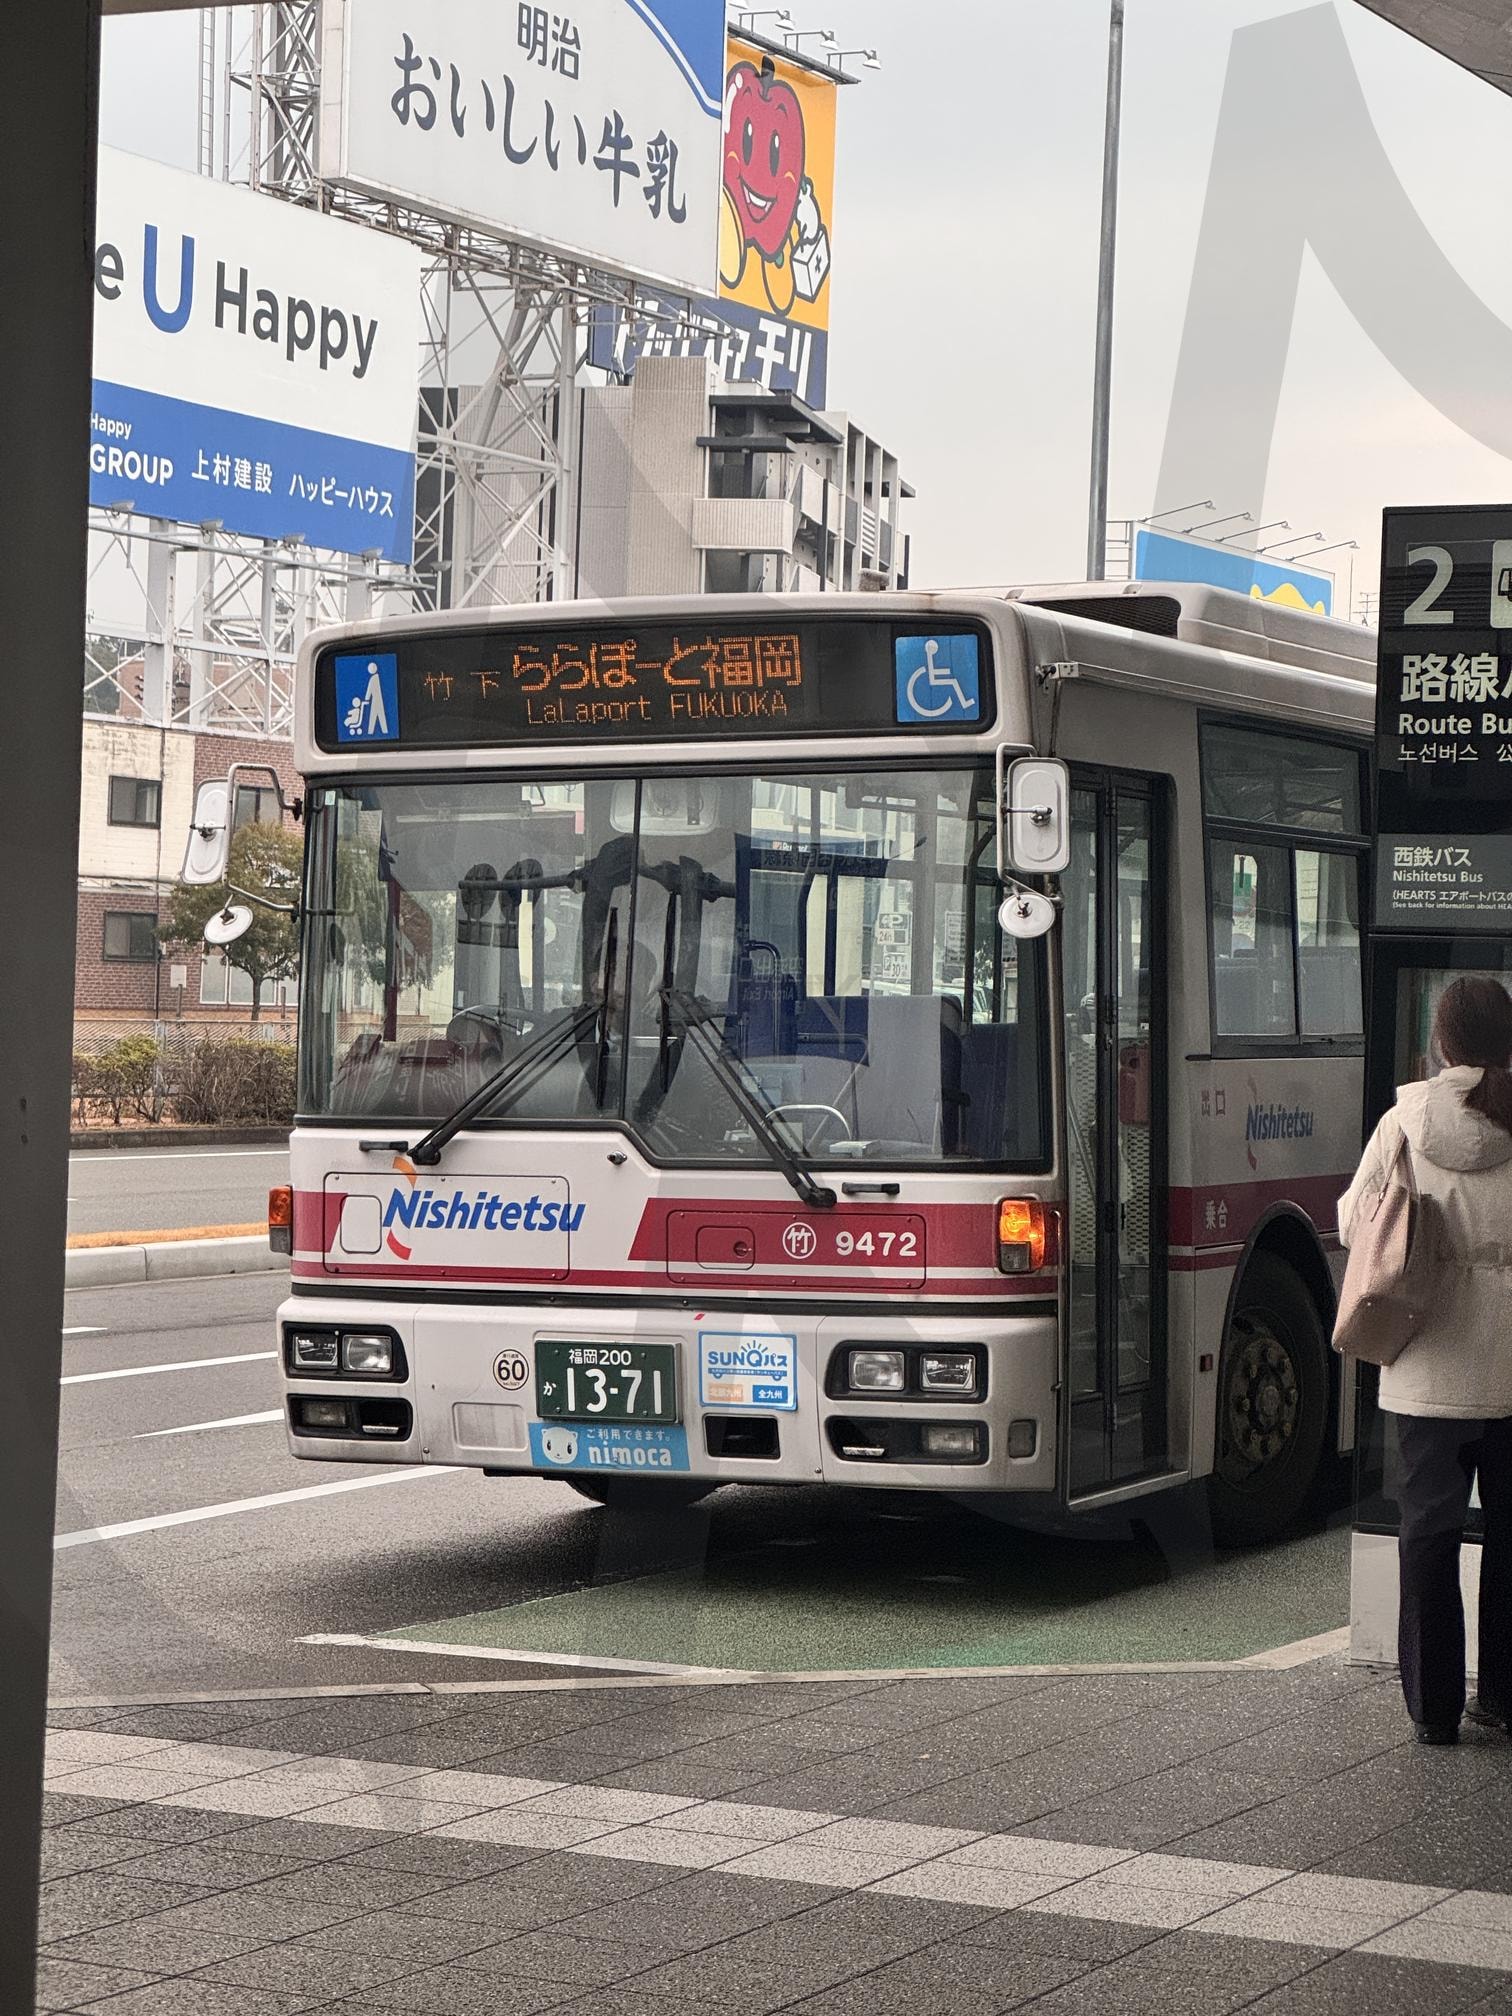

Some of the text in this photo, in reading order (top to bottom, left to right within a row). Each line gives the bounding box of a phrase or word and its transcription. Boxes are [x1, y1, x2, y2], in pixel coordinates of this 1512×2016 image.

[516, 2, 582, 80] 明治
[391, 32, 688, 225] おいしい牛乳
[143, 224, 194, 333] U
[215, 261, 378, 379] Happy
[91, 412, 132, 440] Happy
[90, 443, 174, 486] GROUP
[191, 449, 393, 518] 上村建設 ハッピーハウス
[1404, 546, 1454, 625] 2
[512, 635, 801, 691] ららぽーと福岡
[528, 690, 787, 724] LaLaport FUKUOKA
[1398, 713, 1472, 735] Route
[1398, 743, 1479, 763] 노선버스
[1394, 846, 1472, 867] 西鉄バス
[1393, 870, 1483, 882] Nishitetsu Bus
[1392, 890, 1436, 900] (HEARTS
[1246, 1104, 1314, 1141] Nishitetsu
[383, 1187, 586, 1232] Nishitetsu
[1206, 1200, 1228, 1231] 乗合
[785, 1225, 917, 1256] 竹 9472
[498, 1360, 525, 1381] 60
[543, 1368, 662, 1415] か 13-71
[758, 1389, 783, 1399] 全九州
[586, 1428, 670, 1441] ご利用できます。
[588, 1441, 672, 1466] nimoca
